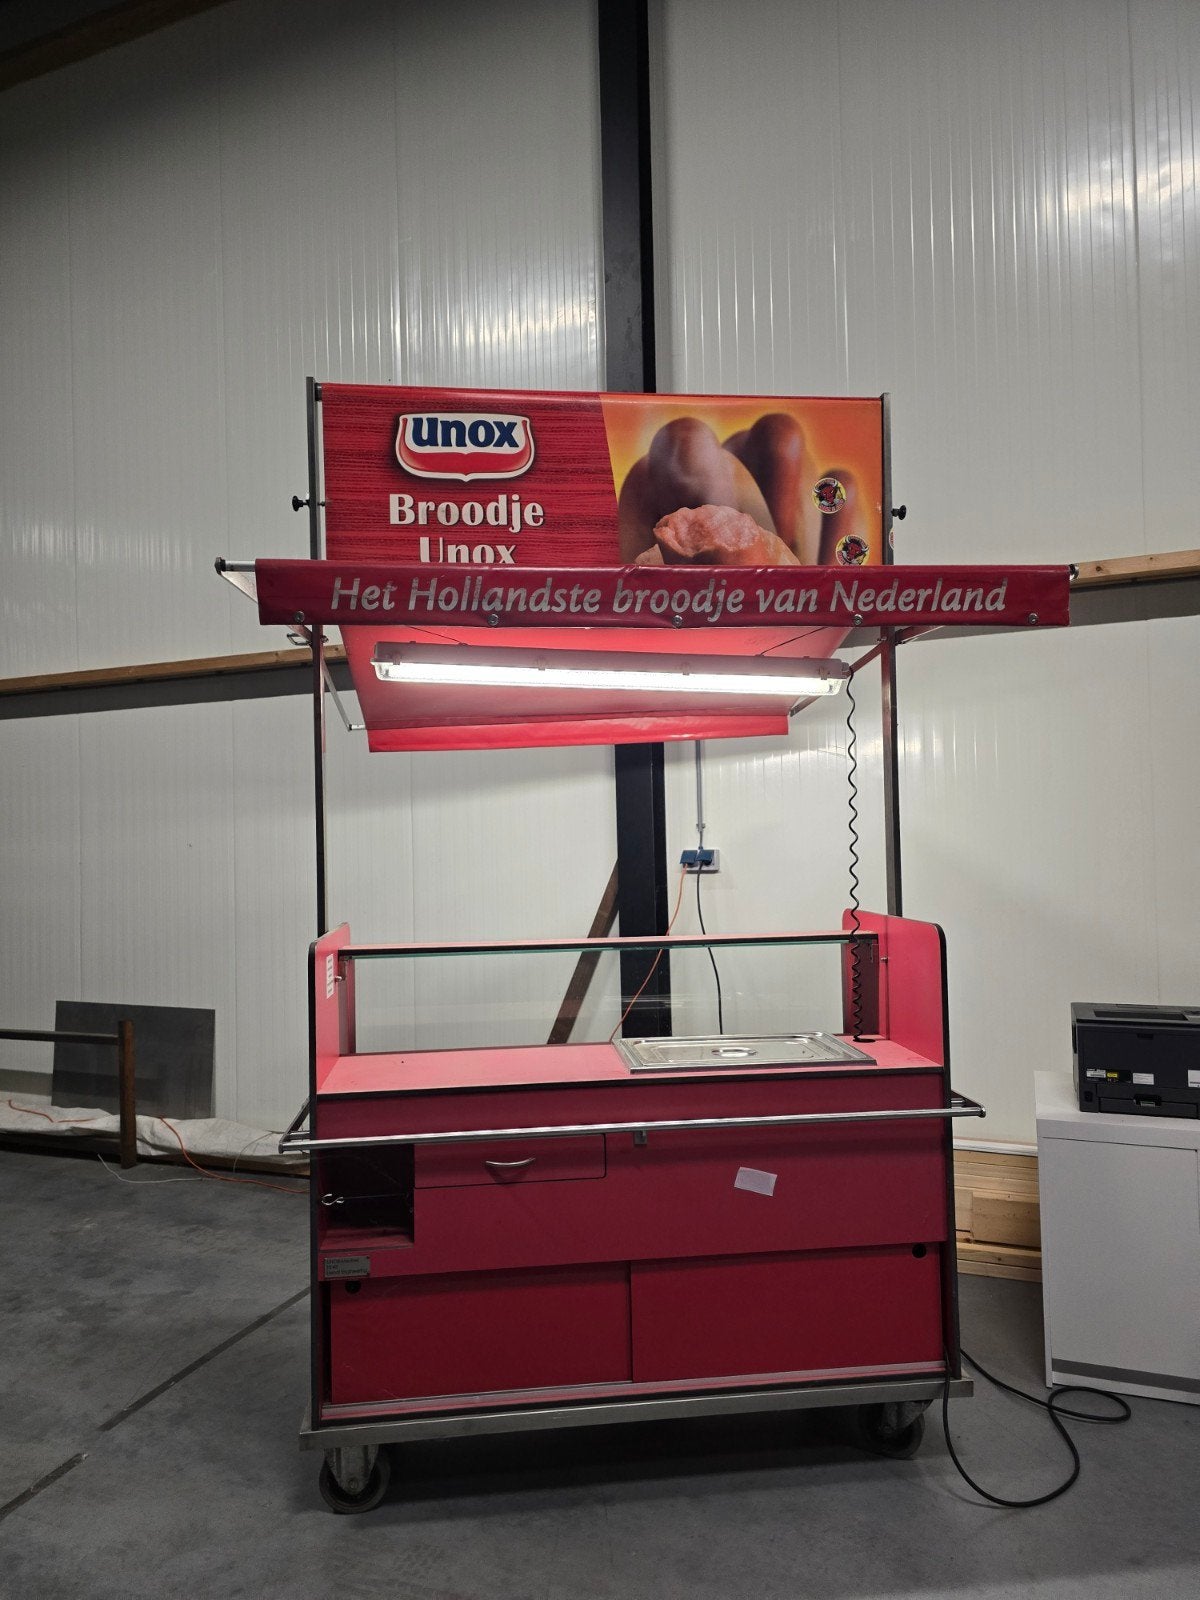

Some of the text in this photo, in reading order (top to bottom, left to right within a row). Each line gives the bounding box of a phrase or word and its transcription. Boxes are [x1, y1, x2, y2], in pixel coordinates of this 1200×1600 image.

[389, 493, 544, 533] Broodje
[419, 536, 516, 564] Unox
[331, 575, 1008, 622] Het Hollandste broodje van Nederland
